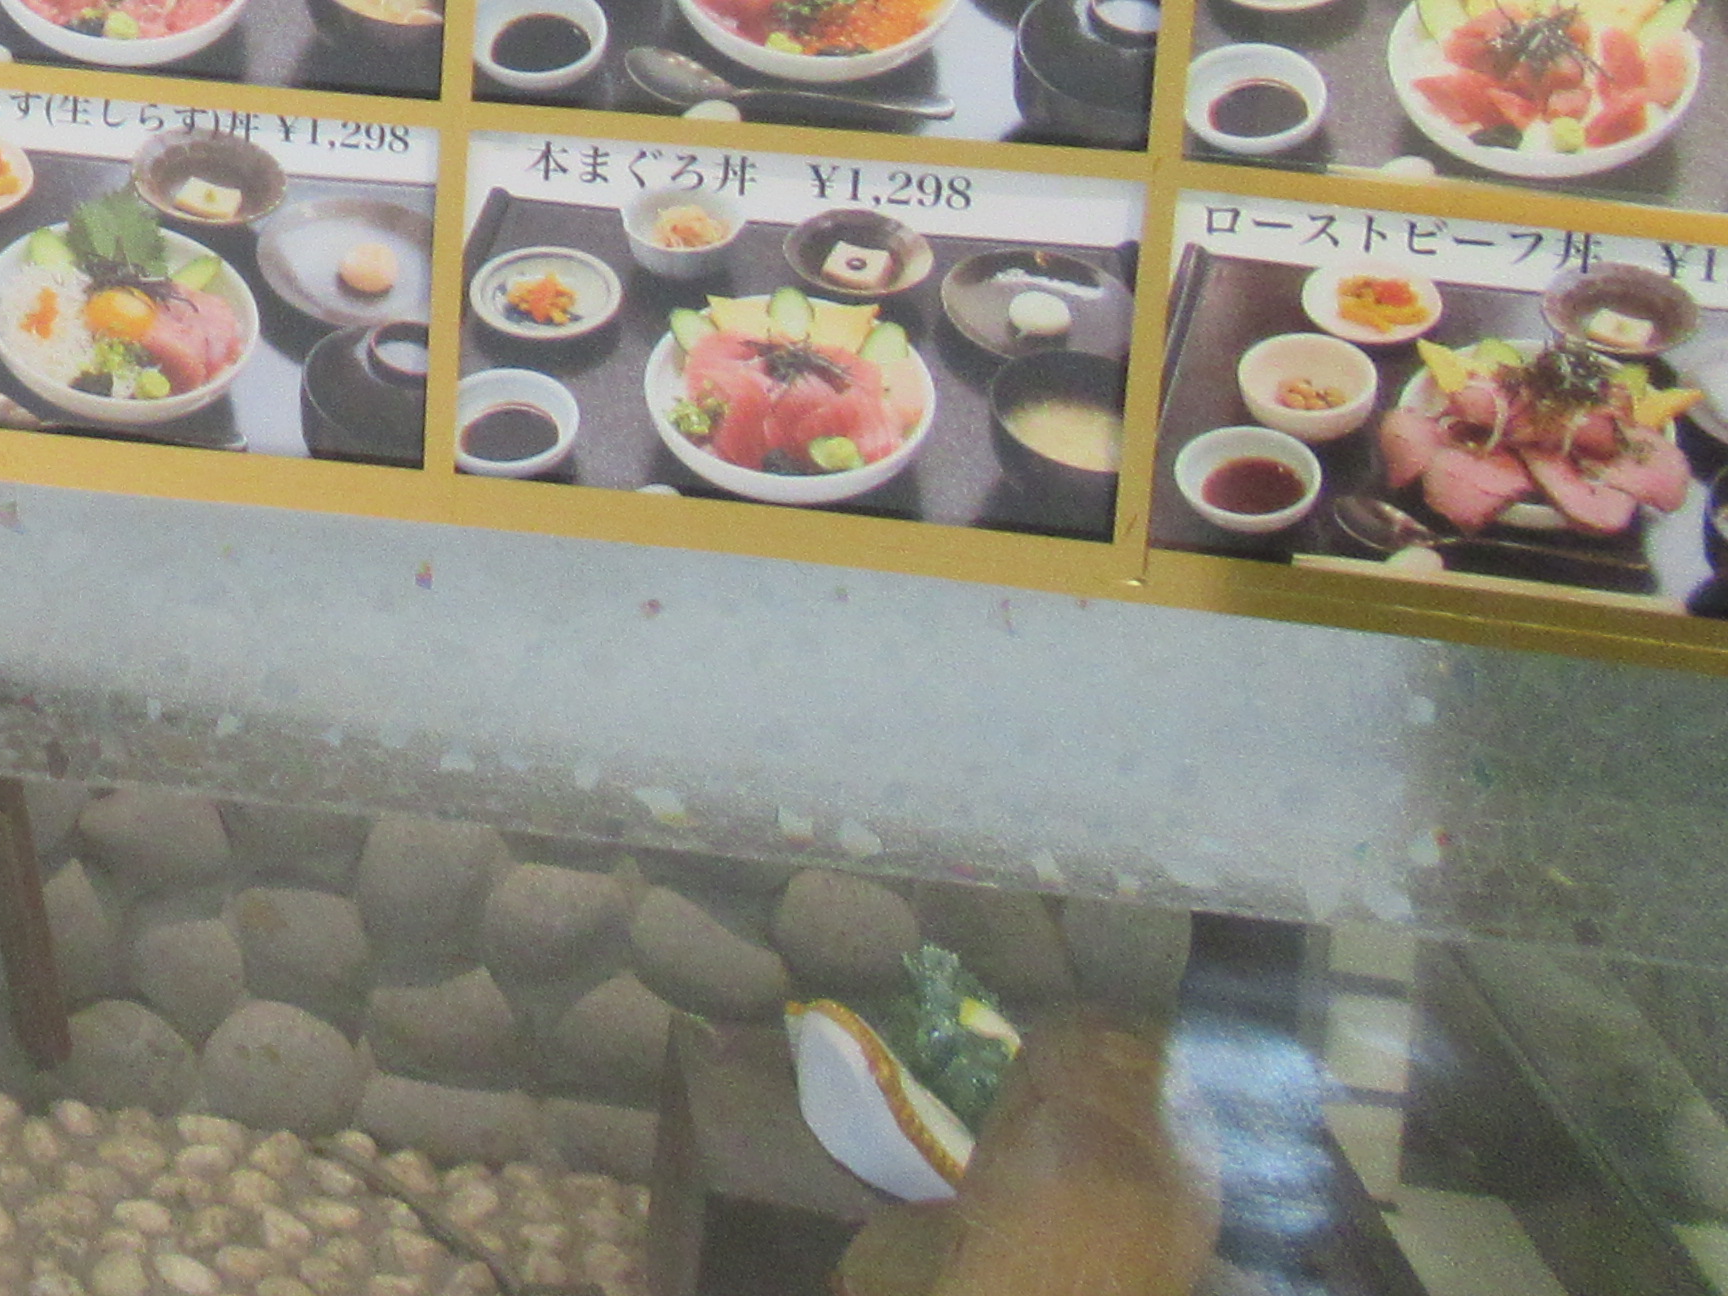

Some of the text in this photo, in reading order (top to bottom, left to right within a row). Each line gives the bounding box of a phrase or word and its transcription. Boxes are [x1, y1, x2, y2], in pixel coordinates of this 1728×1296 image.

[276, 113, 411, 154] ¥1,298
[525, 141, 974, 210] 本まぐろ丼 ¥1,298
[1204, 205, 1603, 274] ローストビーフ丼
